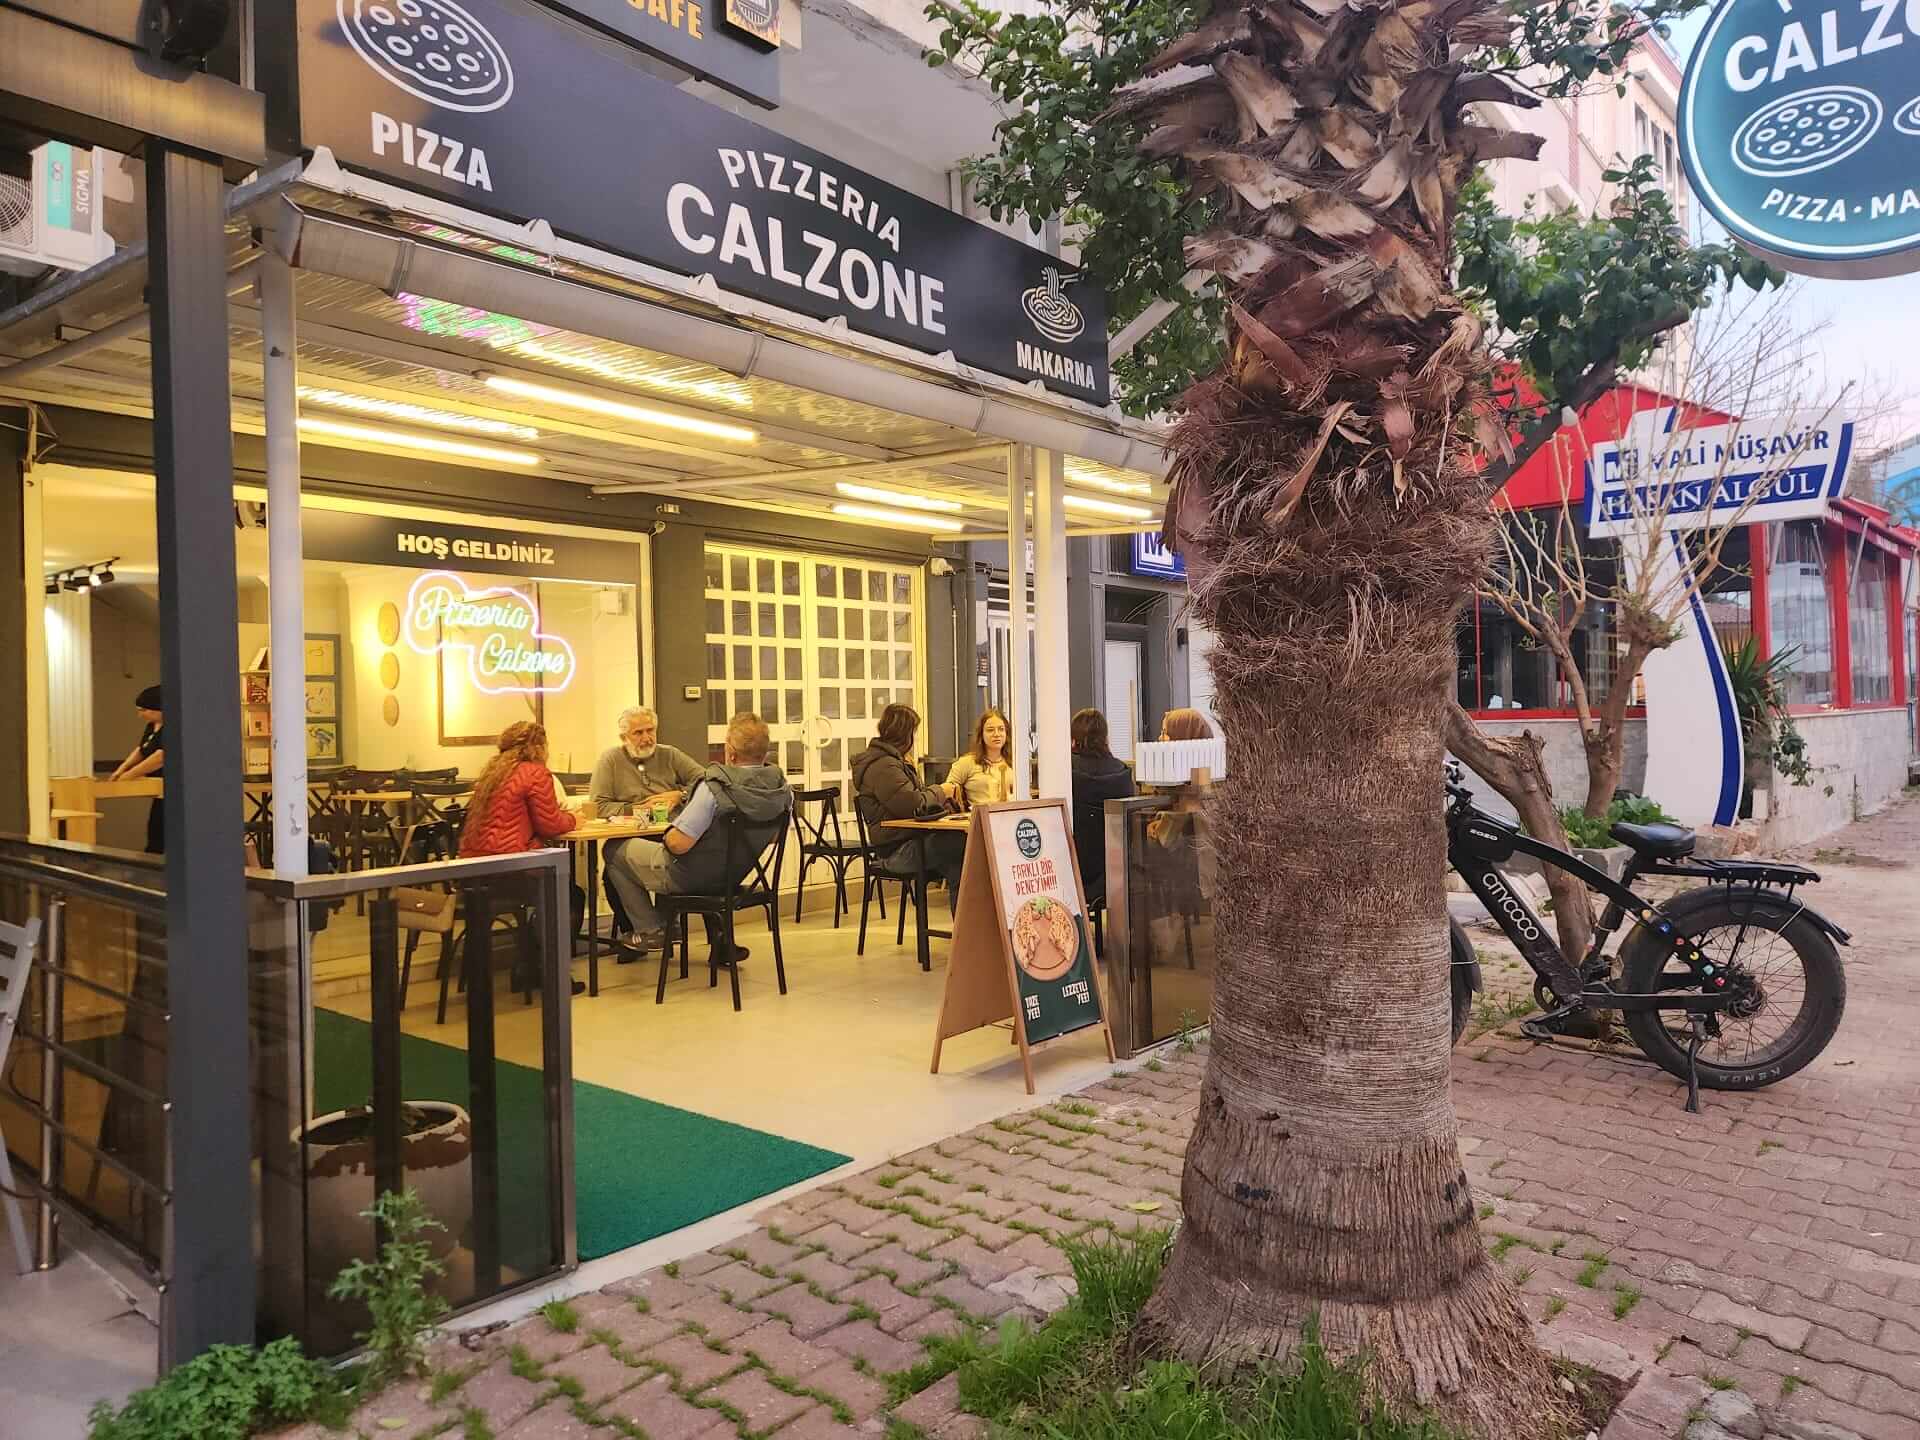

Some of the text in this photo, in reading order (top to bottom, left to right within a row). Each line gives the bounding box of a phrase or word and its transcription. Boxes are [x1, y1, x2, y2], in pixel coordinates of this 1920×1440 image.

[624, 0, 704, 40] AFE
[370, 111, 494, 192] PIZZA
[76, 169, 89, 214] SIGMA
[717, 148, 900, 254] PIZZERIA
[1761, 188, 1847, 222] PIZZA
[665, 181, 947, 336] CALZONE
[1015, 340, 1097, 391] MAKARNA
[397, 533, 555, 565] HOŞ GELDİNİZ
